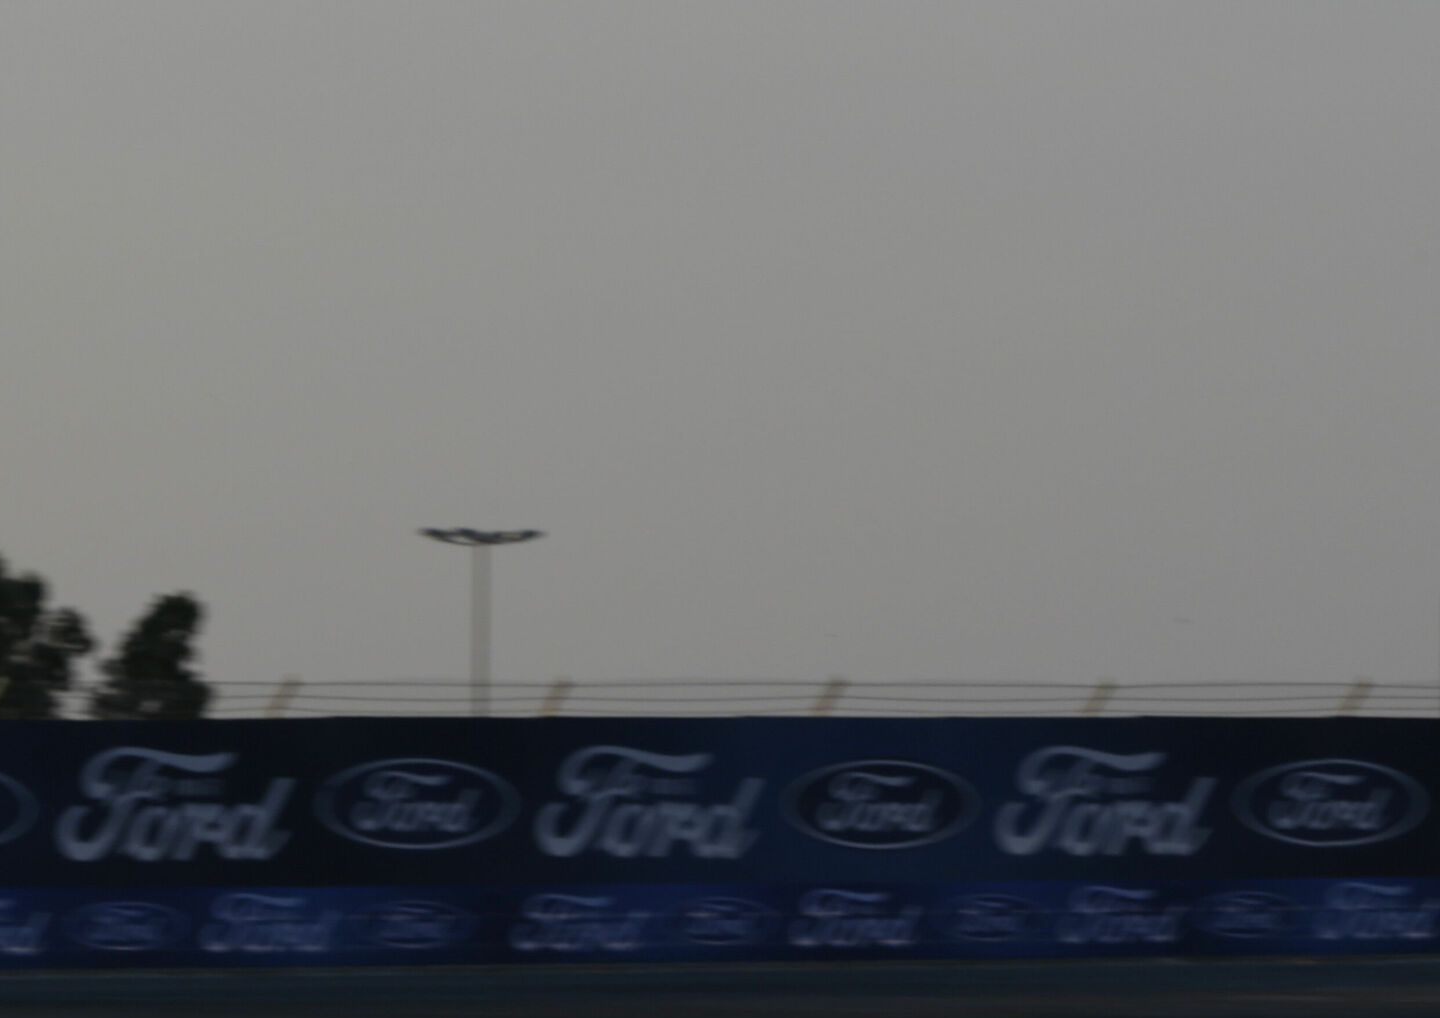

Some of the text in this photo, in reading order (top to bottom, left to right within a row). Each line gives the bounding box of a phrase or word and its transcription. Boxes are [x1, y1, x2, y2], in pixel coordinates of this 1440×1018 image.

[53, 746, 297, 862] Ford
[349, 770, 482, 833] Ford
[532, 745, 767, 859] Ford
[814, 771, 943, 832] Ford
[993, 745, 1219, 856] Ford
[1266, 771, 1394, 830] Ford
